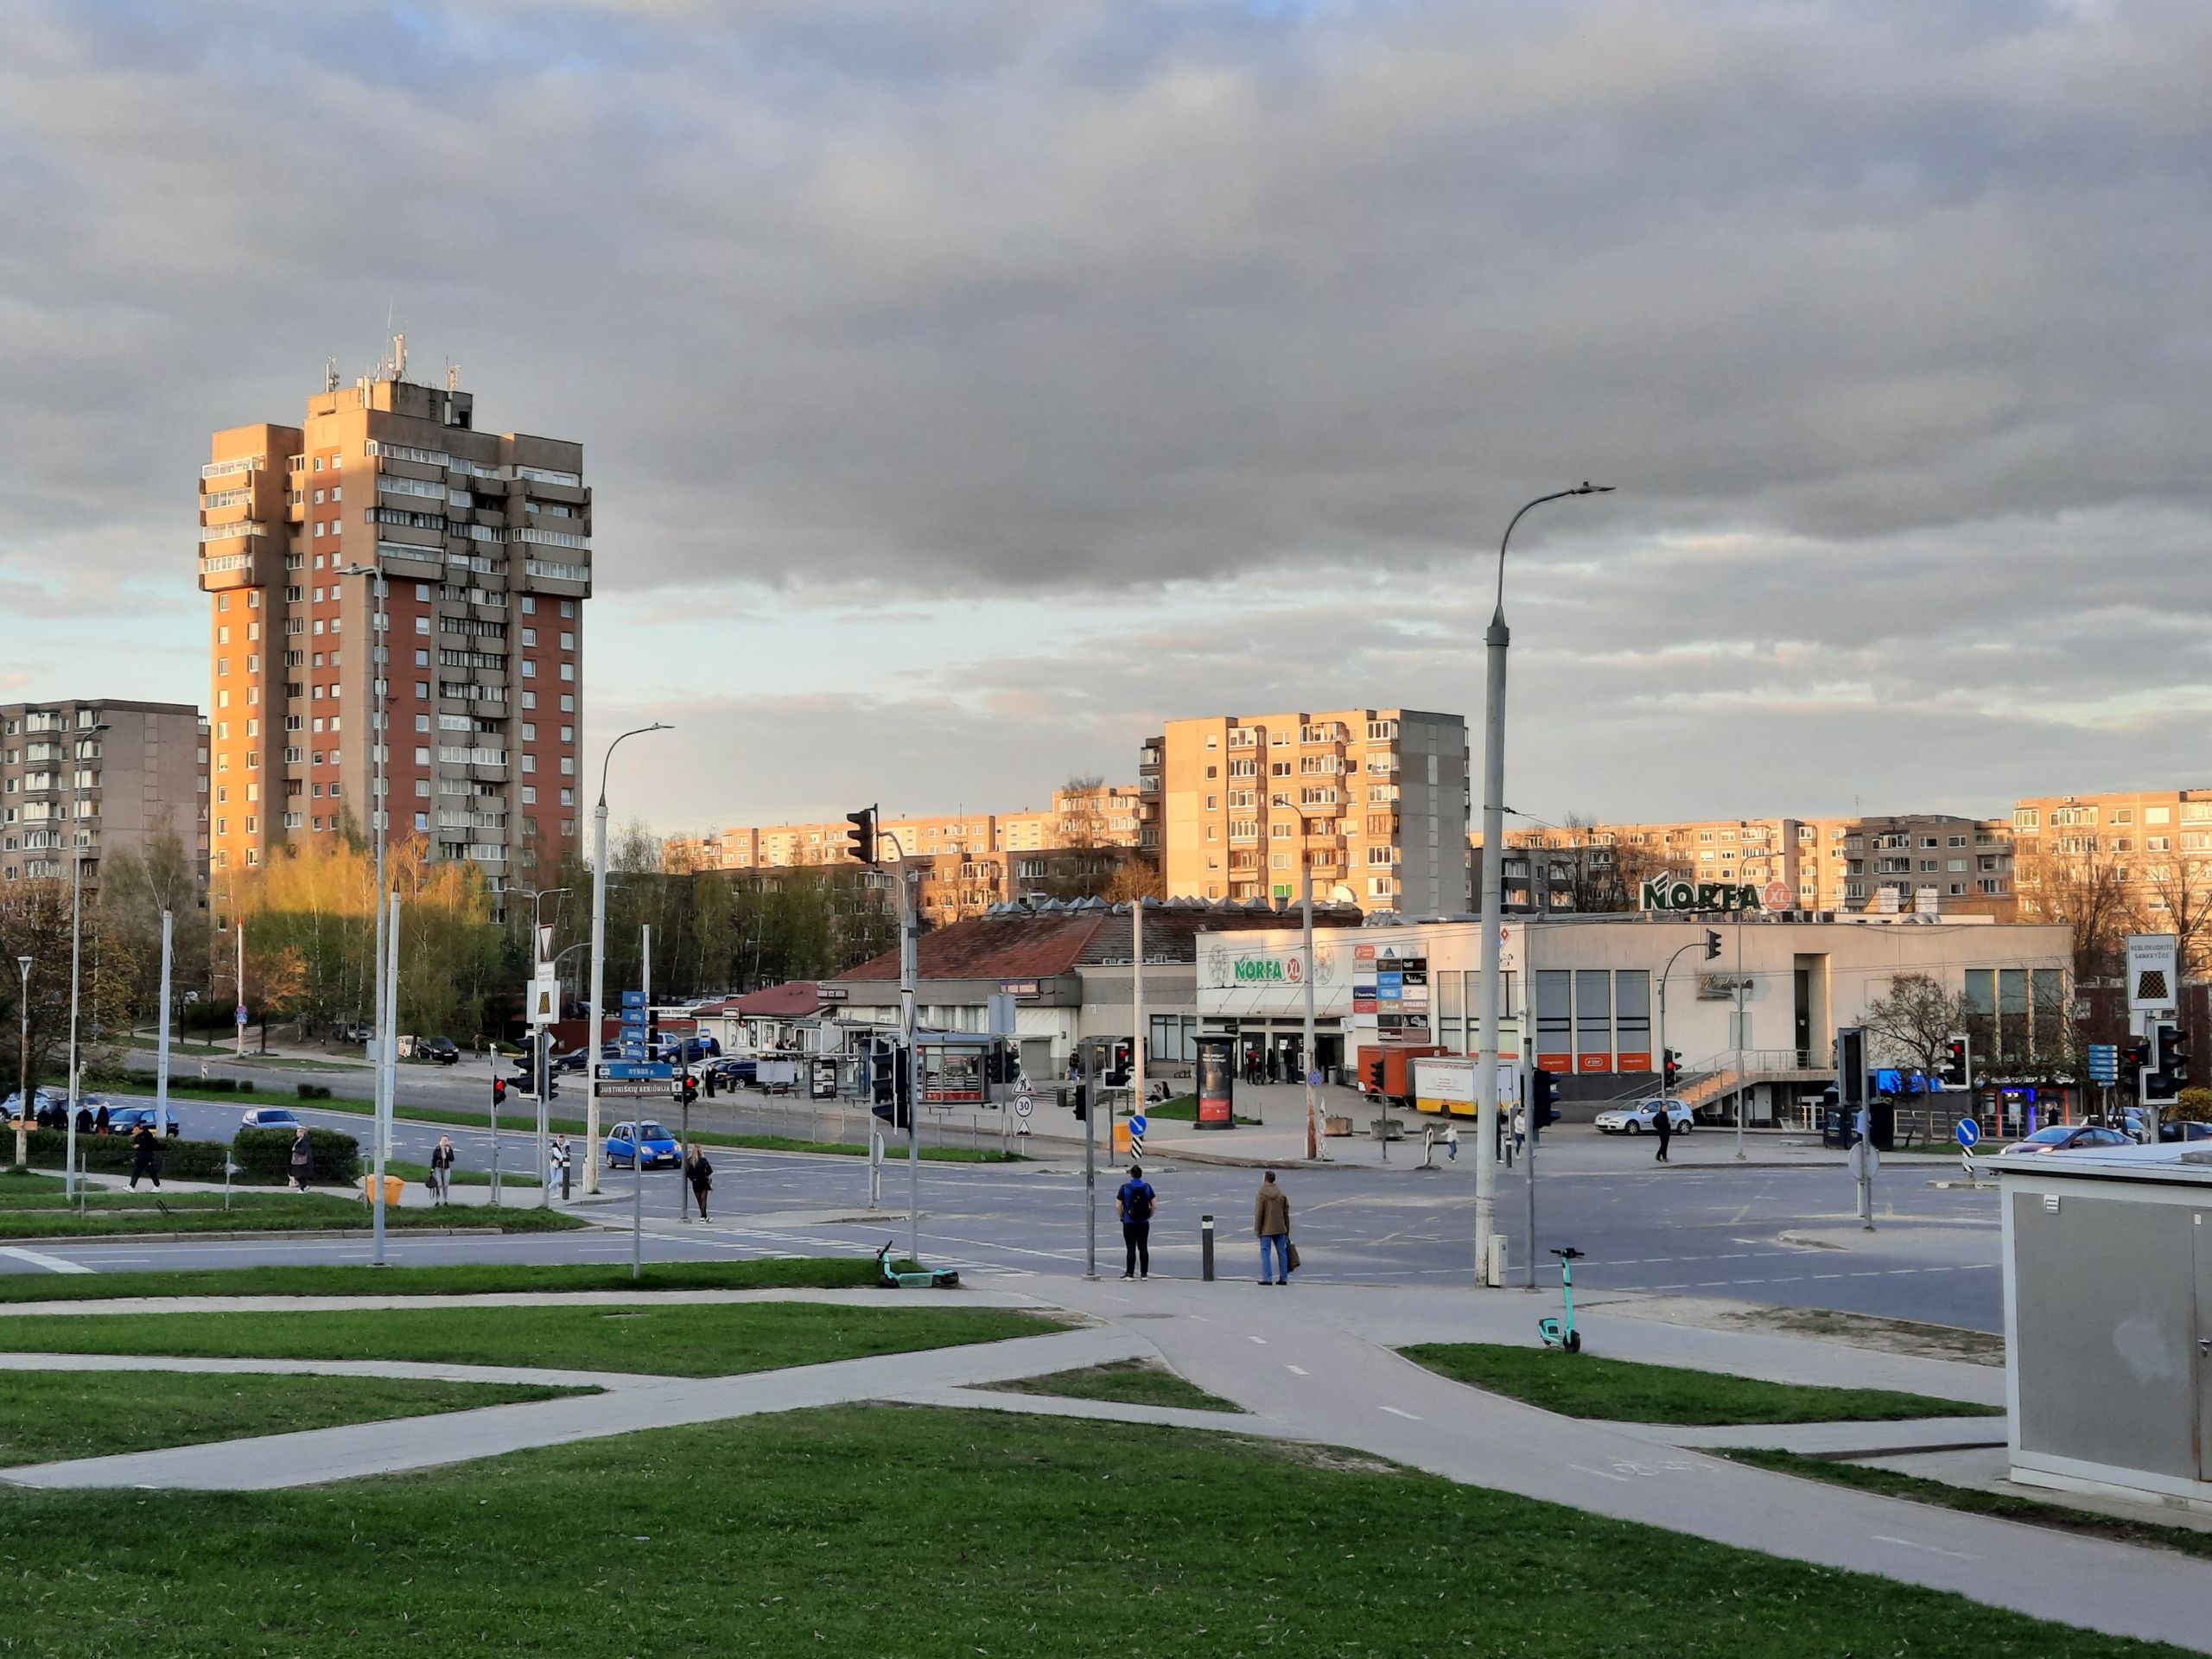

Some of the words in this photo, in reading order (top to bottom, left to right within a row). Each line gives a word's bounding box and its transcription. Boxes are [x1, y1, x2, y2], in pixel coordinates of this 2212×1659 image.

[1641, 876, 1761, 910] NORFA
[1768, 888, 1786, 904] XL
[1234, 958, 1283, 980] NORFA
[1288, 960, 1300, 976] XL
[1019, 1101, 1030, 1111] 30
